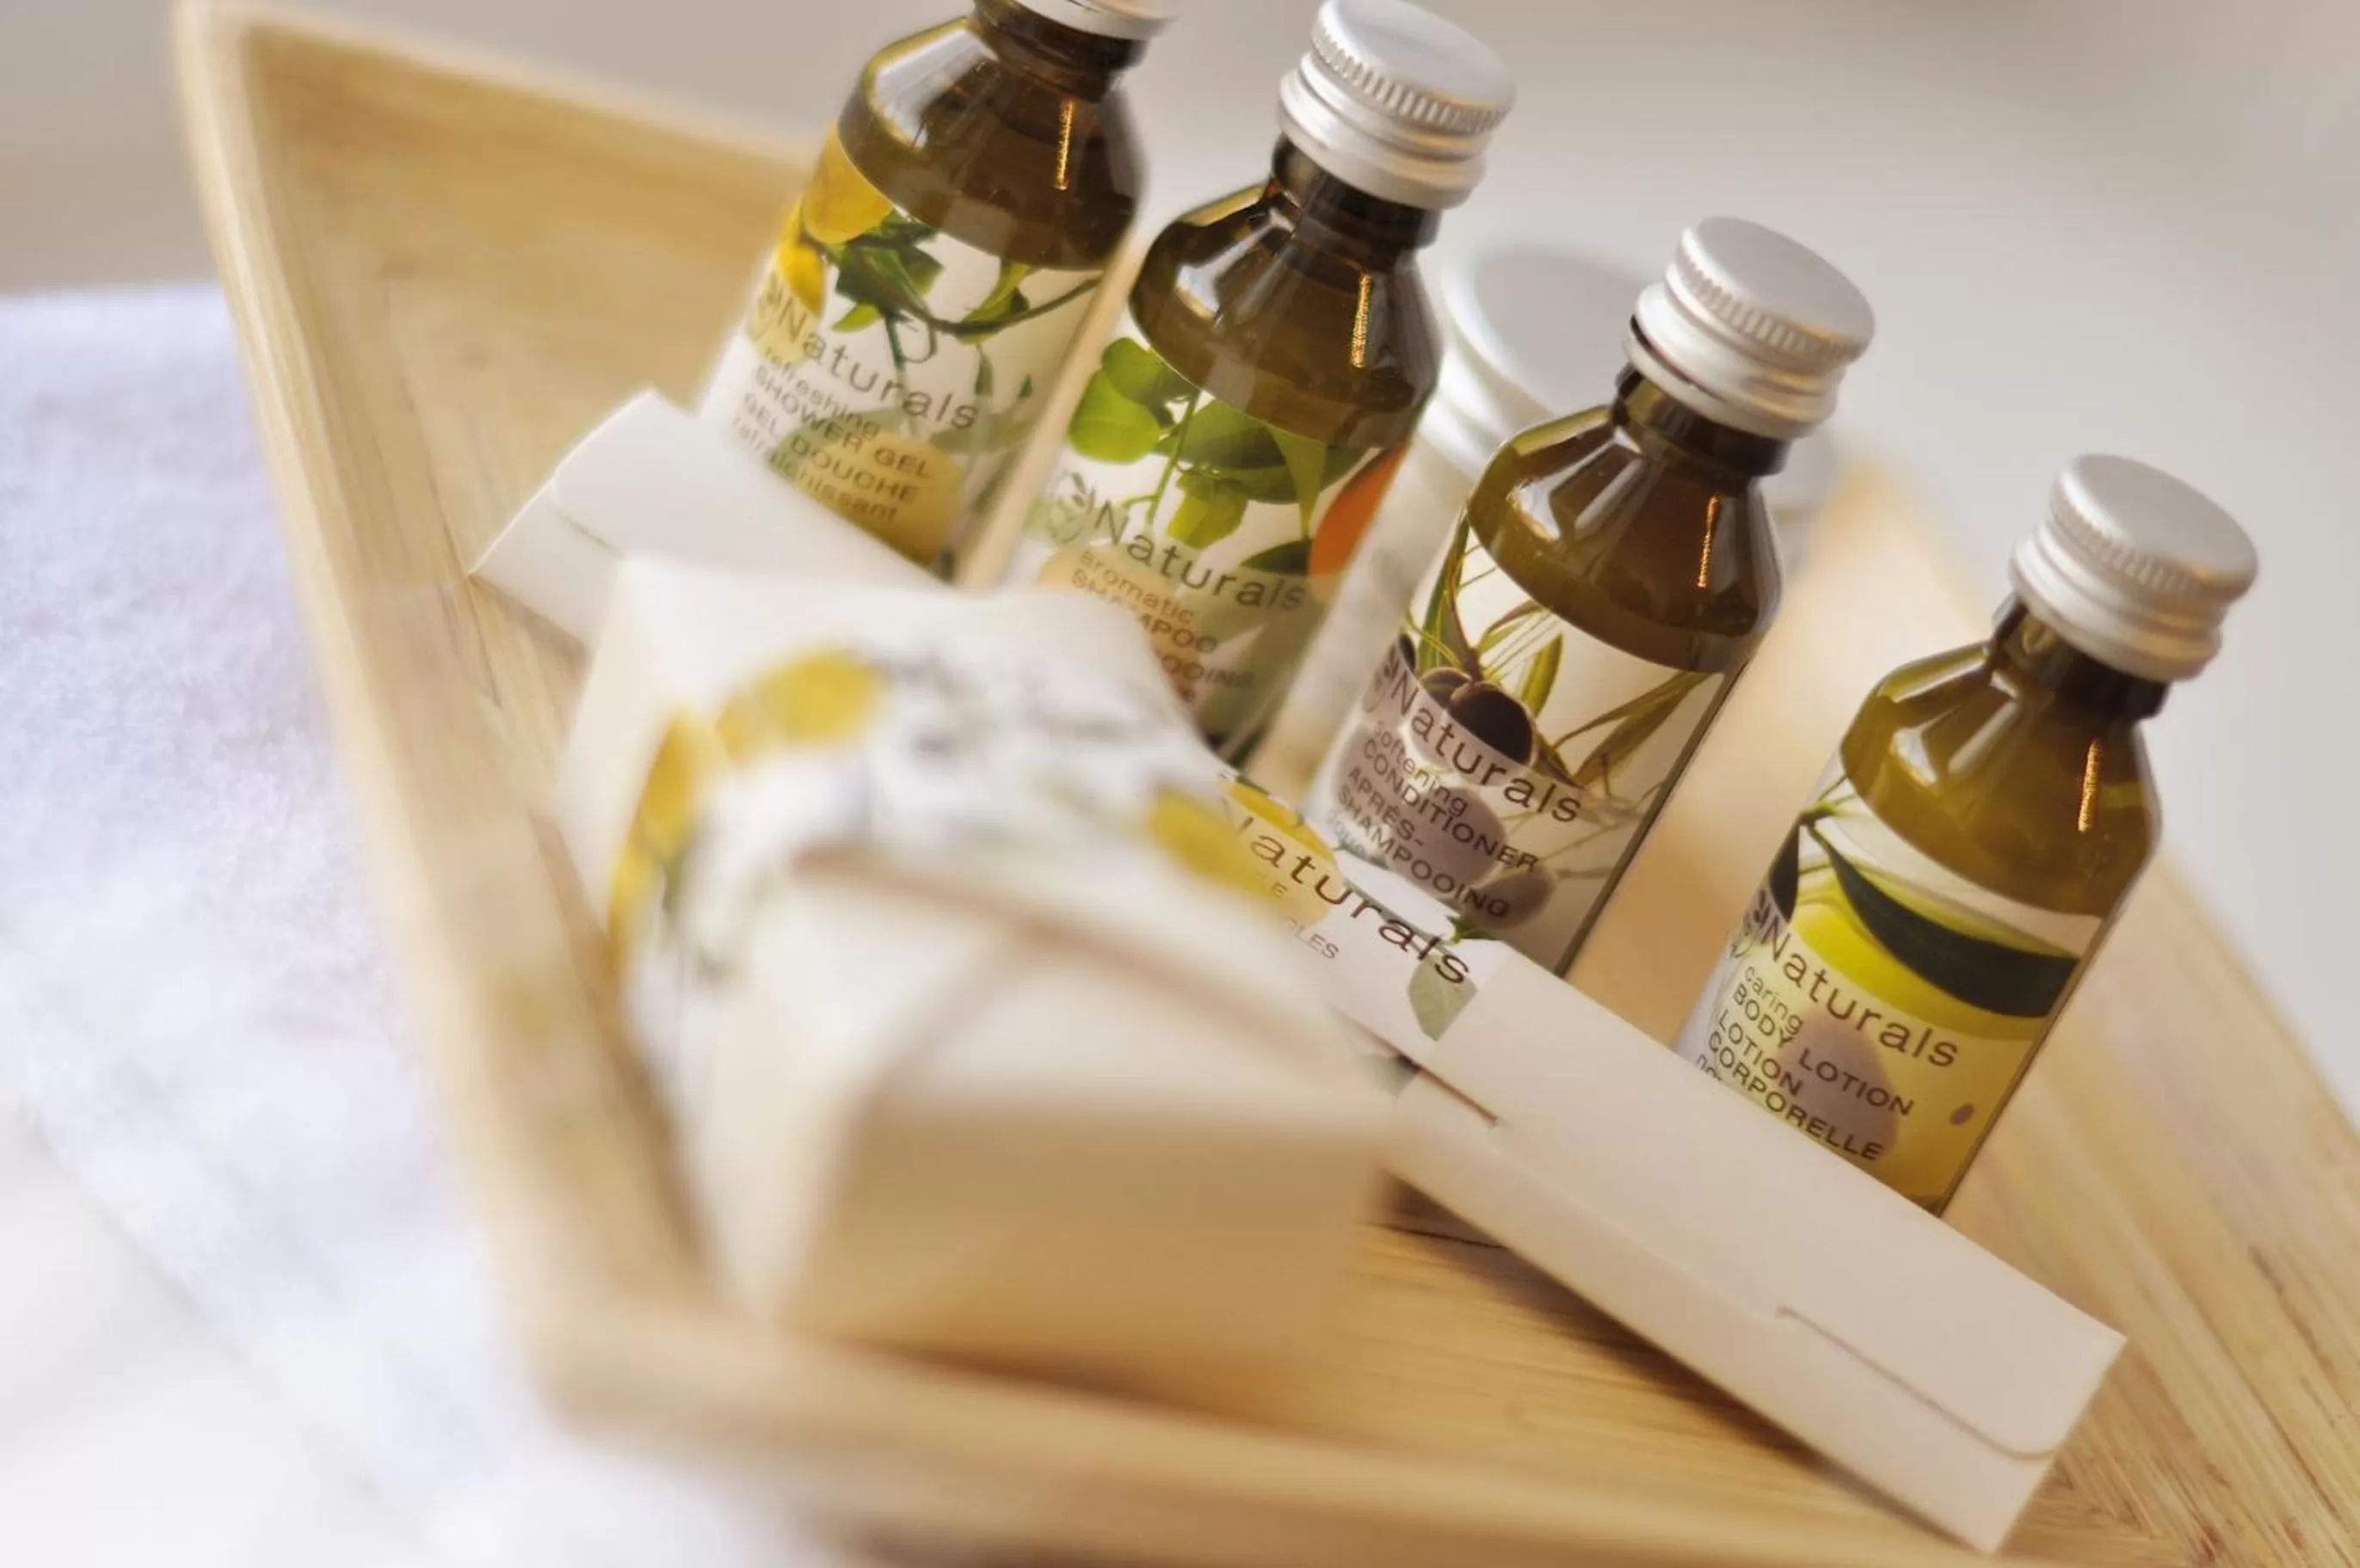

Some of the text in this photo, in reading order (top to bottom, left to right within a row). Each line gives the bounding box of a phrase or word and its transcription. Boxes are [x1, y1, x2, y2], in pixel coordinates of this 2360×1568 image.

[755, 364, 933, 479] SHOWER GEL
[776, 300, 980, 431] Naturals
[791, 434, 919, 503] DOUCHE
[1080, 550, 1195, 624] aromatic
[1094, 499, 1307, 612] Naturals
[1364, 739, 1539, 873] CONDITIONER
[1377, 721, 1470, 818] softening
[1390, 673, 1581, 823] Naturals
[1338, 783, 1511, 918] SHAMPOOING
[1733, 983, 1796, 1049] BODY
[1798, 1047, 1915, 1117] LOTION
[1744, 965, 1804, 1036] caring
[1760, 914, 1959, 1068] Naturals
[1708, 1030, 1884, 1162] CORPORELLE
[1717, 1008, 1804, 1098] LOTION
